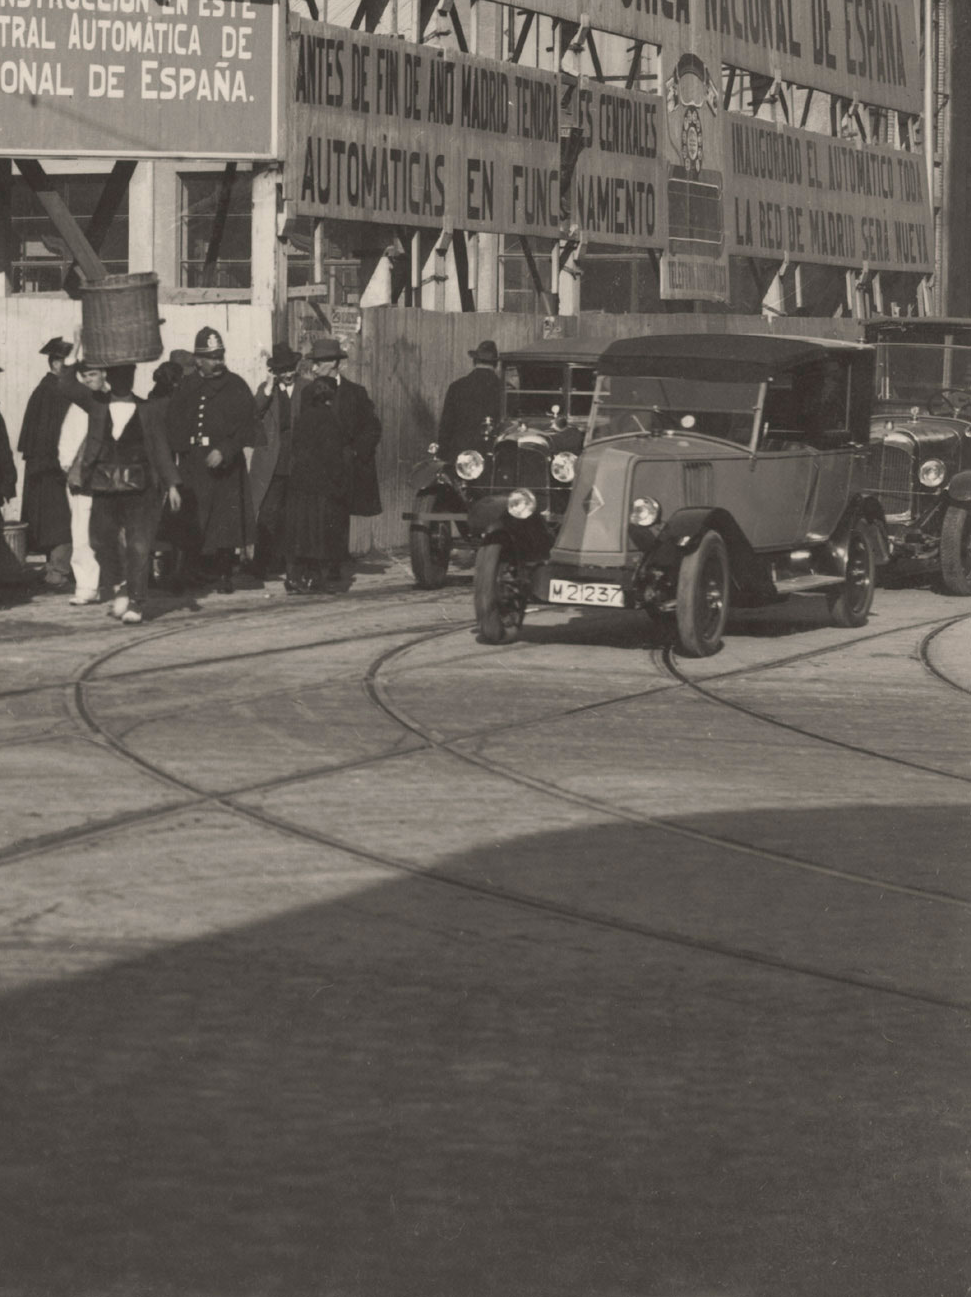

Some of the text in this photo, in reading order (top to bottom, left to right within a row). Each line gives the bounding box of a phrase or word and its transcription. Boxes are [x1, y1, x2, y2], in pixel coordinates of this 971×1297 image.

[67, 13, 202, 57] AUTOMÁTICA
[221, 25, 253, 60] DE
[88, 63, 126, 99] DE
[140, 60, 256, 103] ESPAÑA.
[295, 34, 345, 109] ANTES
[351, 42, 370, 114] DE
[404, 53, 422, 122] DE
[428, 51, 456, 127] AÑO
[461, 63, 509, 135] MADRID
[599, 93, 658, 160] CENTRALES
[731, 122, 803, 187] INAUGURADO
[805, 139, 823, 190] EL
[896, 156, 925, 203] TODA
[467, 157, 495, 222] EN
[512, 164, 656, 237] FUNCNAMIENTO
[734, 196, 754, 247] LA
[758, 199, 784, 251] RED
[787, 204, 805, 253] DE
[809, 209, 857, 259] MADRID
[552, 583, 563, 599] M
